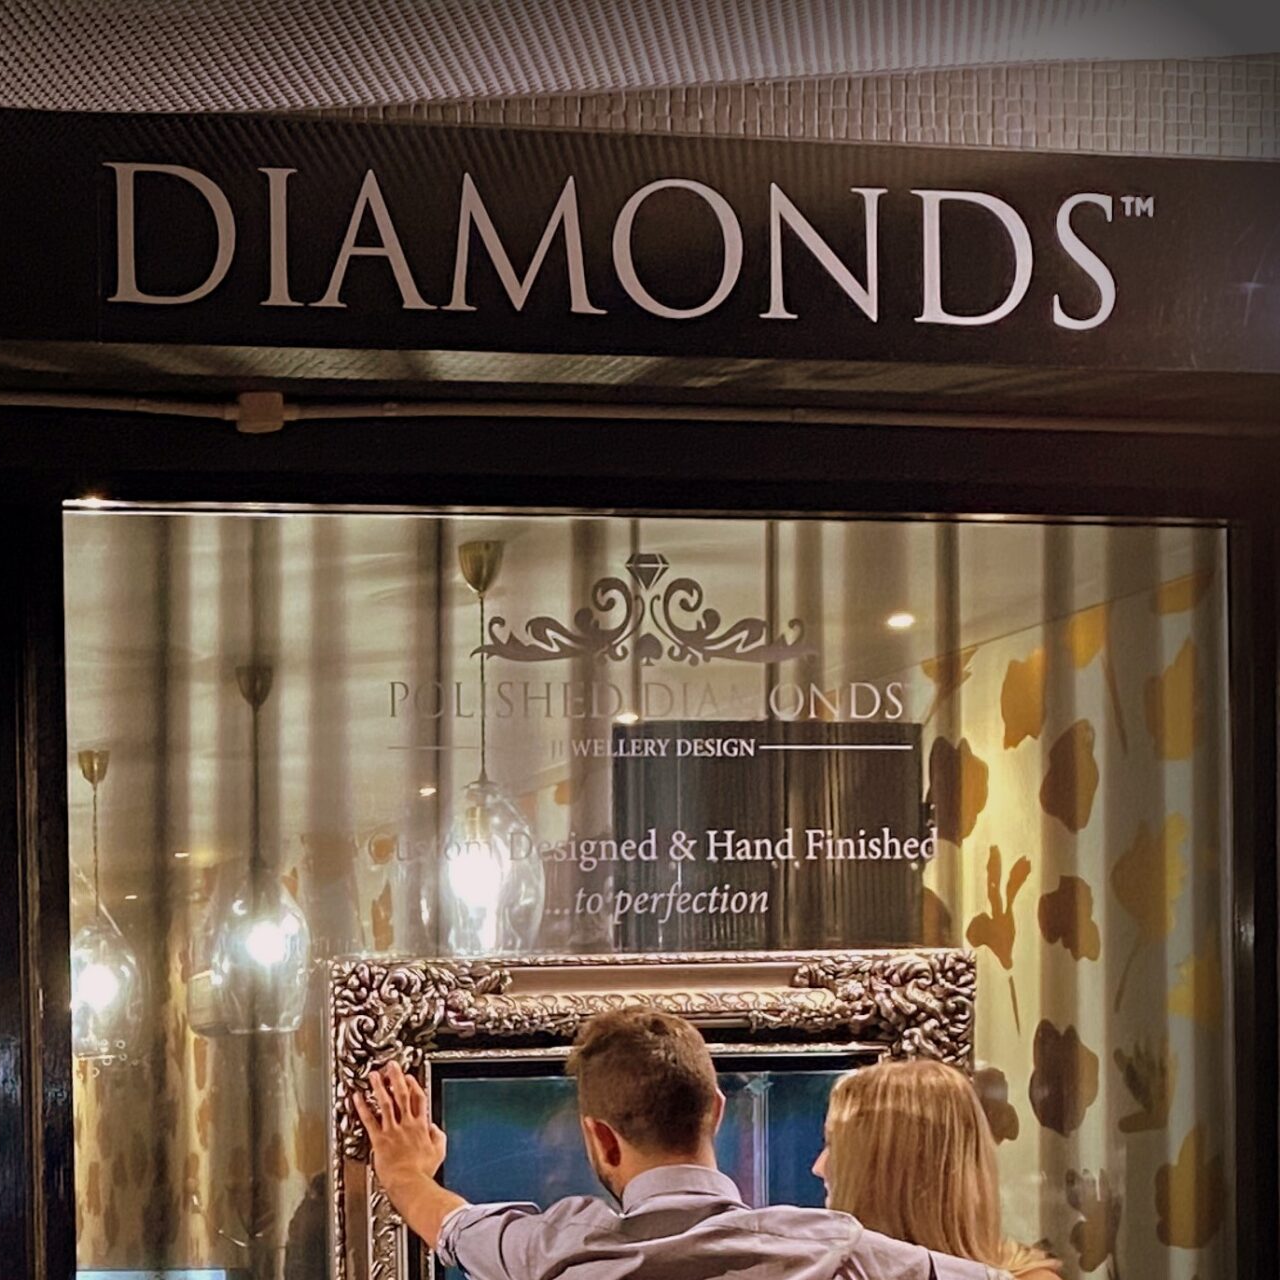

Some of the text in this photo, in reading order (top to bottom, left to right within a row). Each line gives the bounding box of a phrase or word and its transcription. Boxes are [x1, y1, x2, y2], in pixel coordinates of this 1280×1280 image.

[104, 160, 1116, 331] DIAMONDS
[389, 680, 903, 720] POLISHED DIAONDS
[676, 738, 756, 757] DESIGN
[368, 827, 938, 872] Cuom Designed & Hand Finished
[612, 881, 769, 925] perfection
